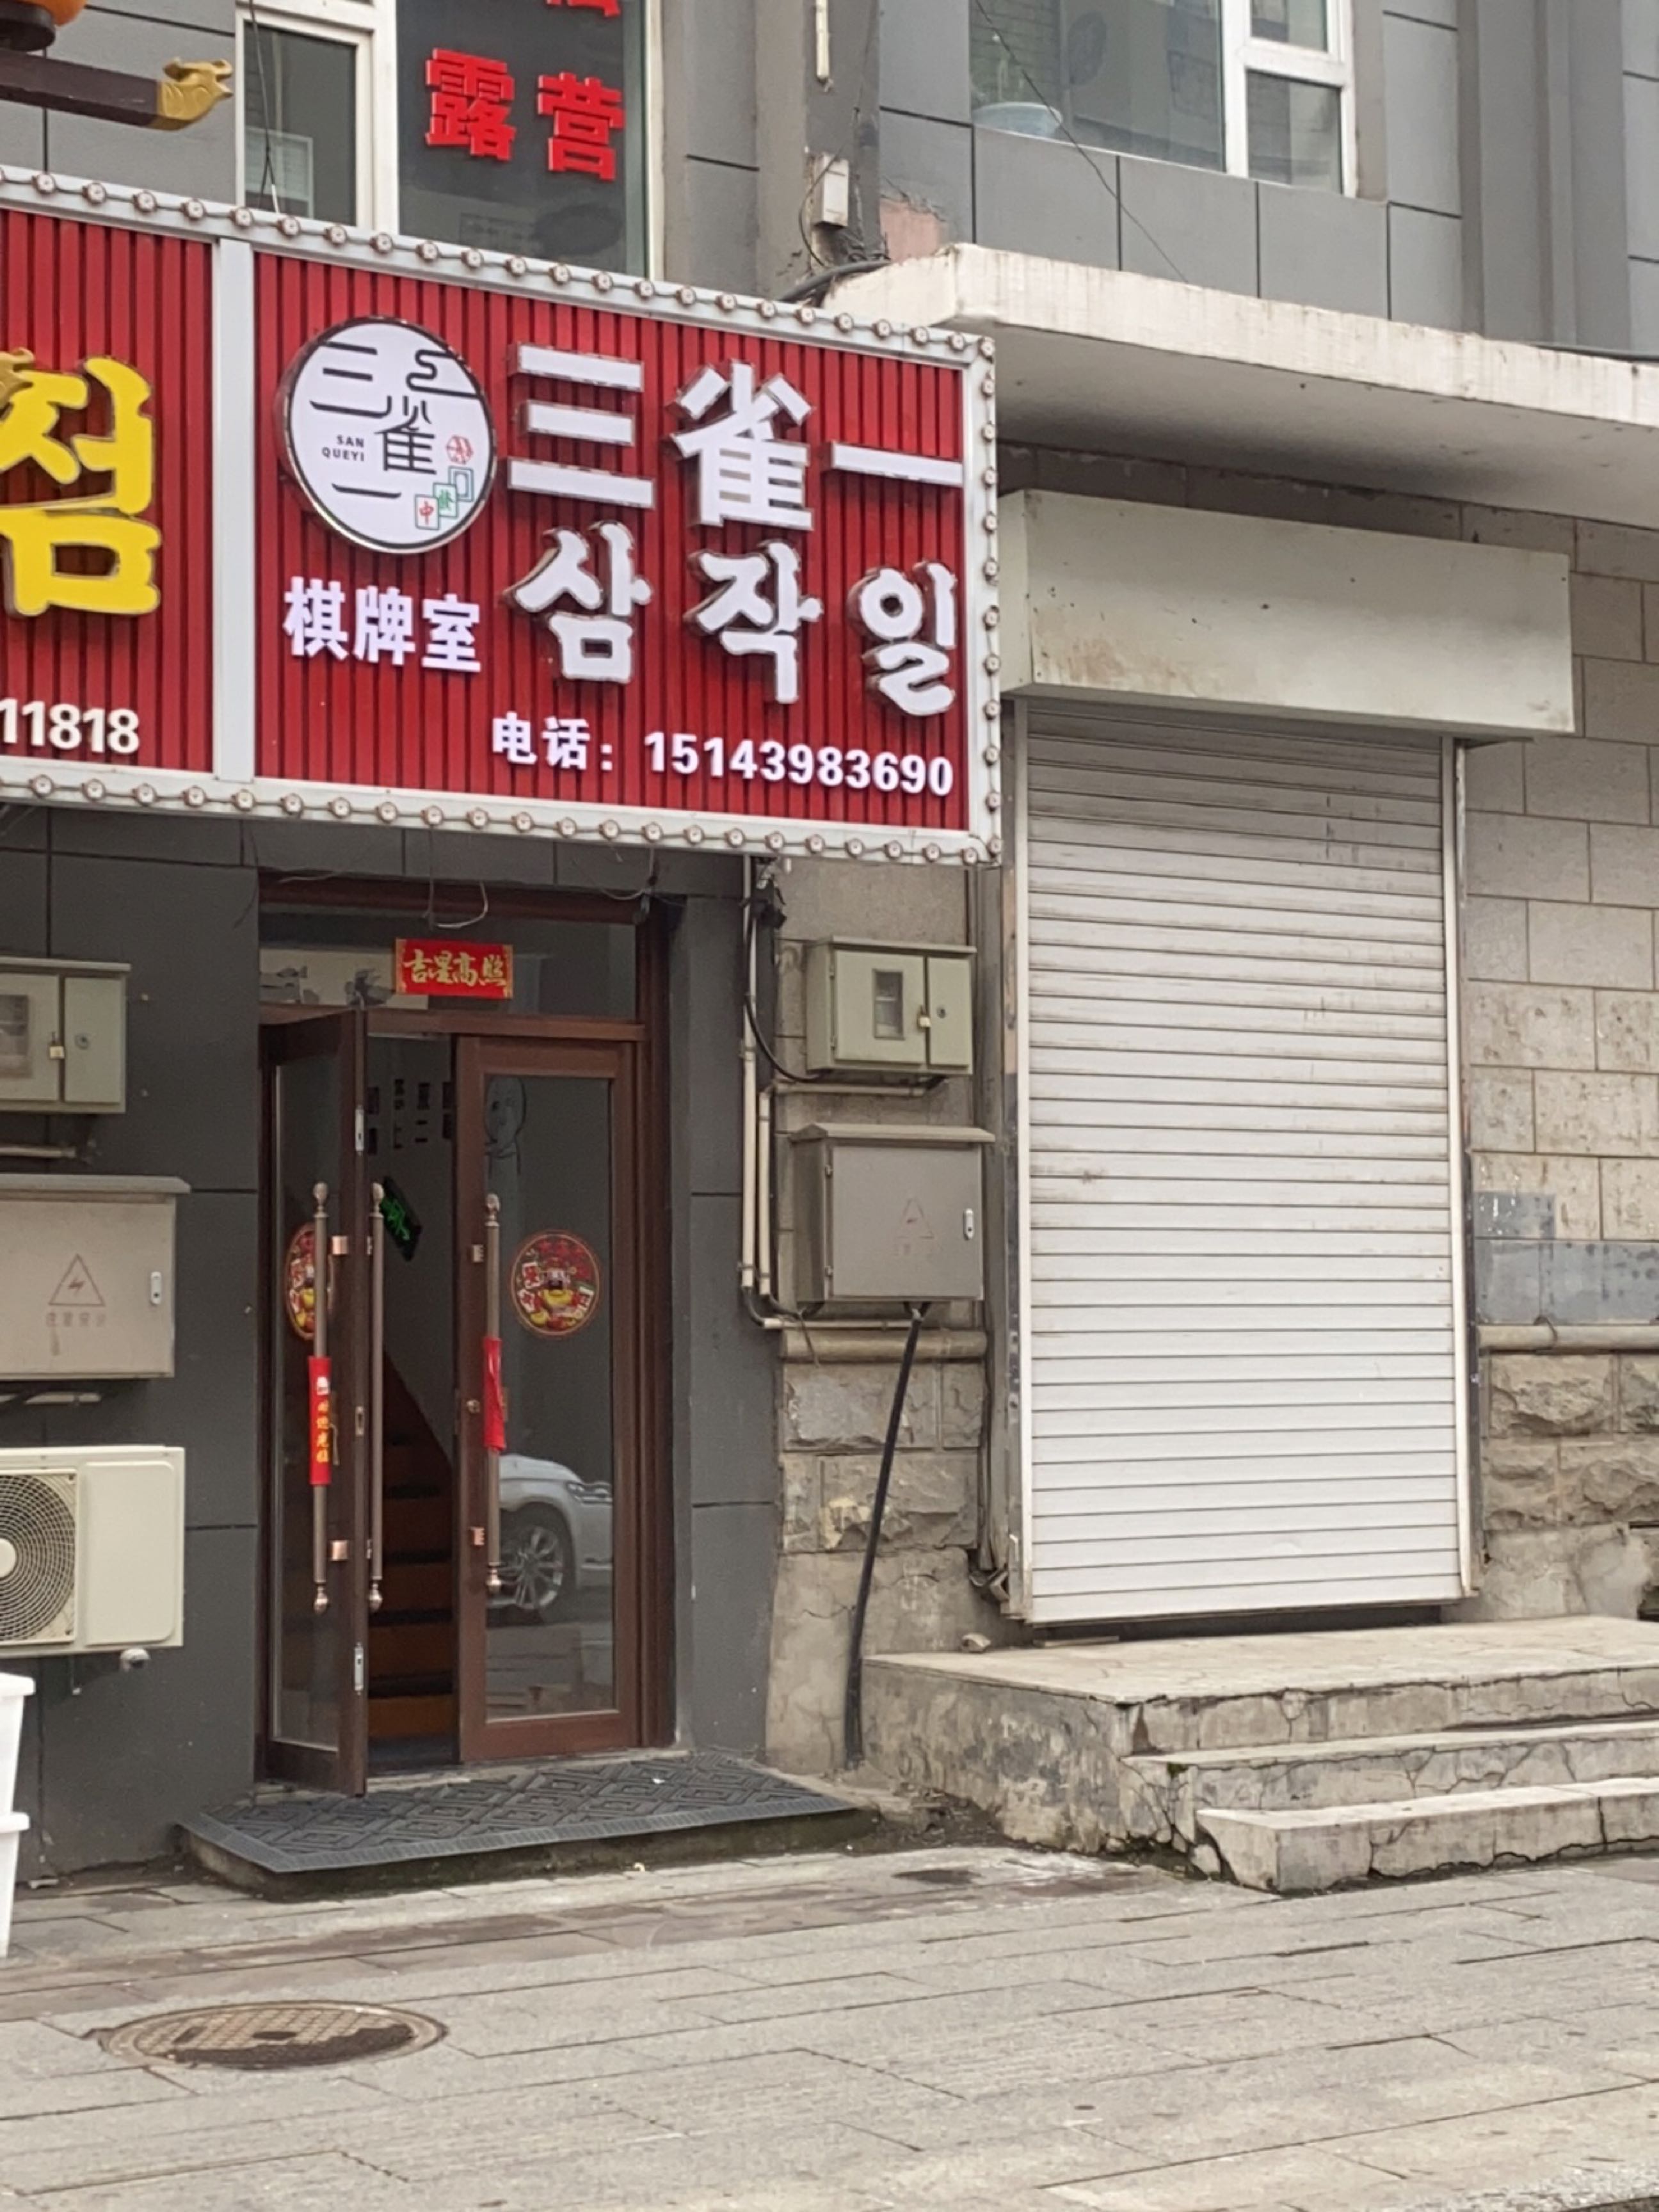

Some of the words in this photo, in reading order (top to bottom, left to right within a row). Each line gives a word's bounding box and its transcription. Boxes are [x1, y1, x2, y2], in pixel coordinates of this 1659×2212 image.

[425, 48, 625, 181] 露营
[321, 447, 365, 461] QUEYI
[337, 435, 364, 448] SAN
[506, 344, 965, 531] 三雀一
[419, 501, 435, 525] 中
[282, 576, 481, 673] 棋牌室
[502, 520, 958, 716] 삼작일
[0, 698, 140, 754] 11818
[644, 732, 954, 797] 15143983690
[402, 949, 506, 987] 吉星高照
